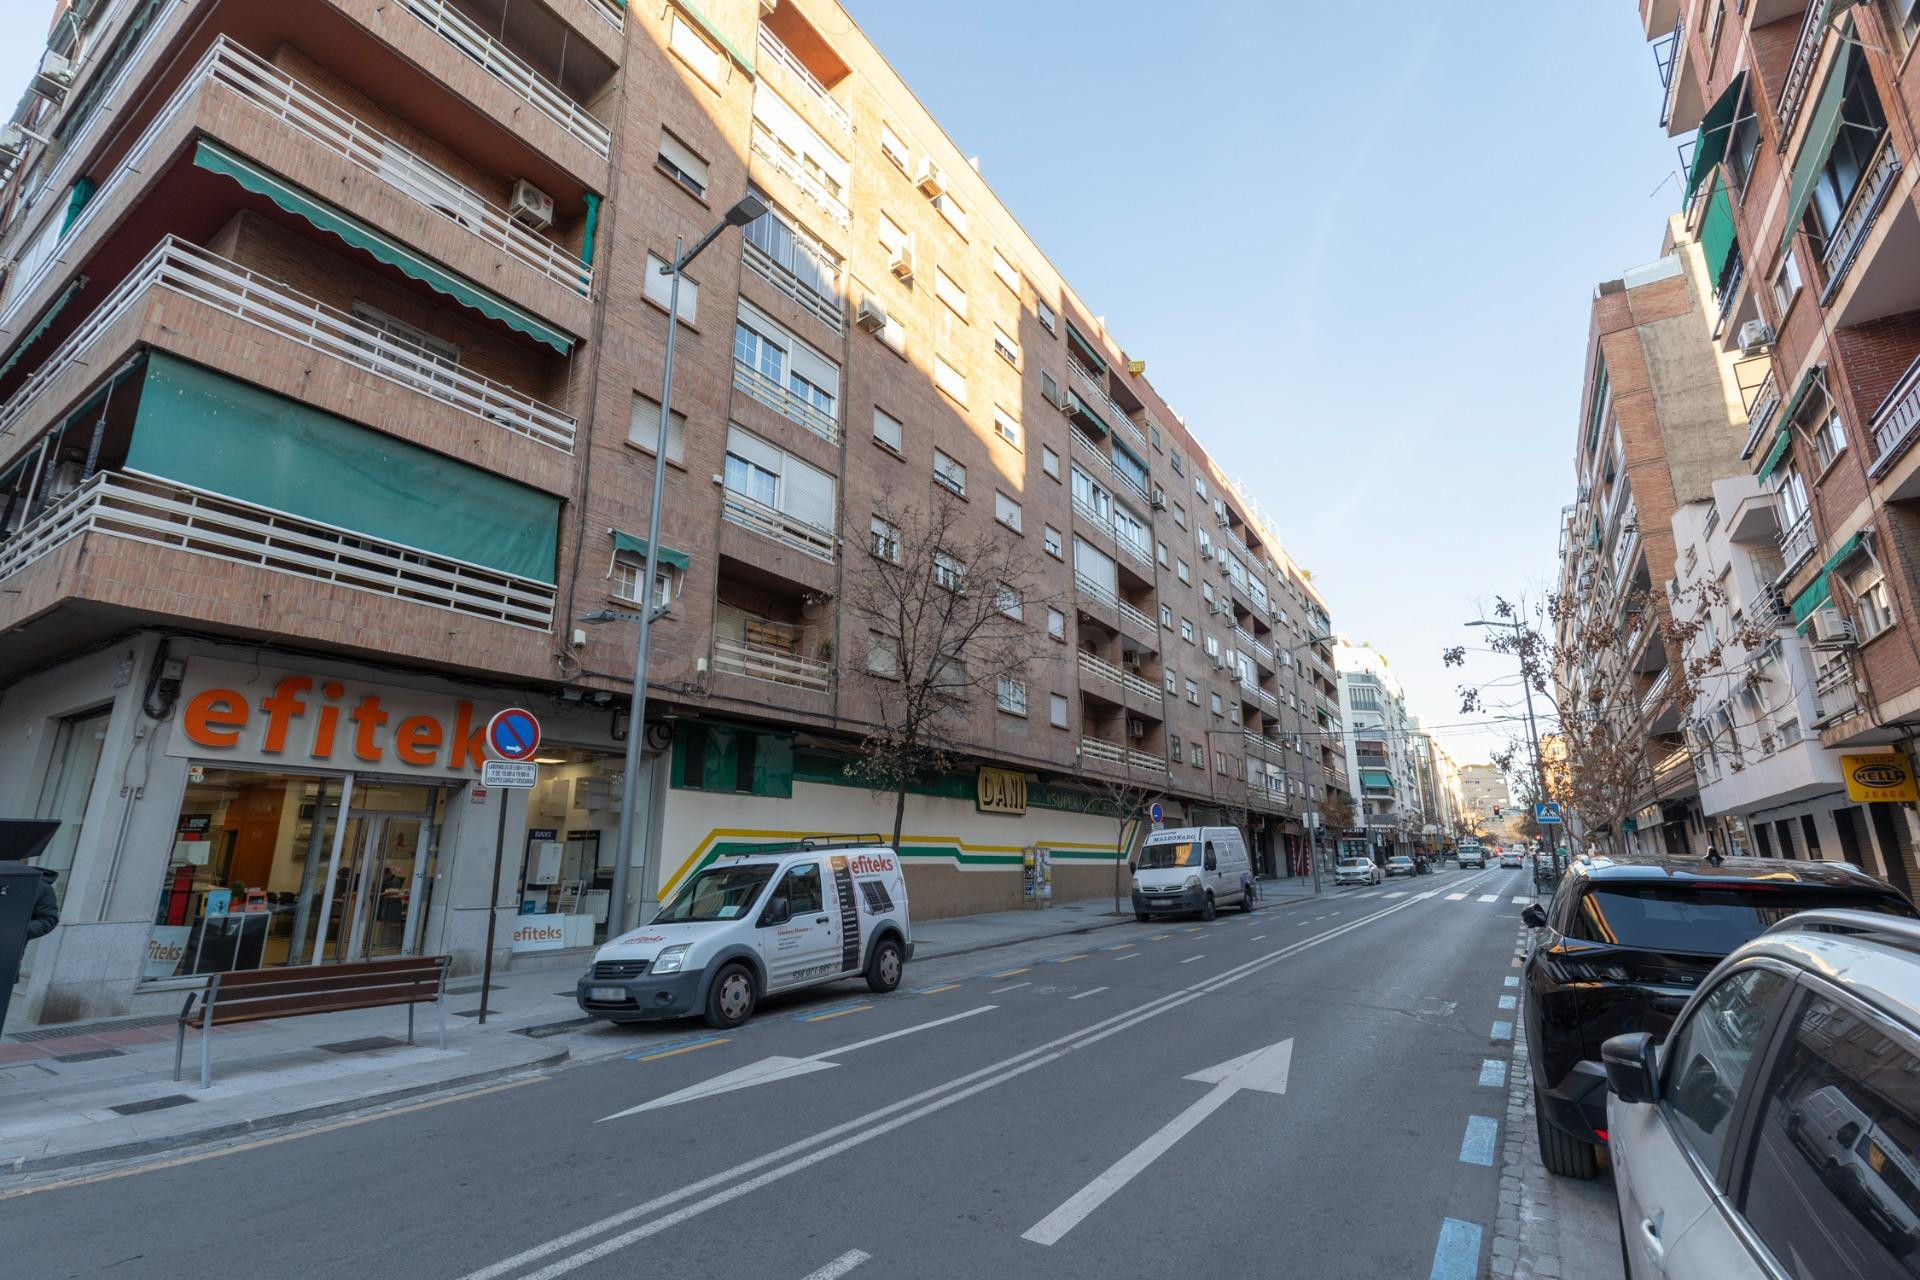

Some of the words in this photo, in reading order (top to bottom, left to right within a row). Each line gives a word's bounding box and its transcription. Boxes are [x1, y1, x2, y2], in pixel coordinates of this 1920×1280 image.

[183, 677, 500, 771] efitek
[1856, 769, 1905, 783] HELLA
[982, 773, 1024, 810] DANI
[1863, 790, 1906, 798] JESUS
[1153, 834, 1195, 842] MALDONADO
[851, 854, 893, 874] efiteks
[513, 925, 562, 942] efiteks
[148, 940, 184, 960] fiteks
